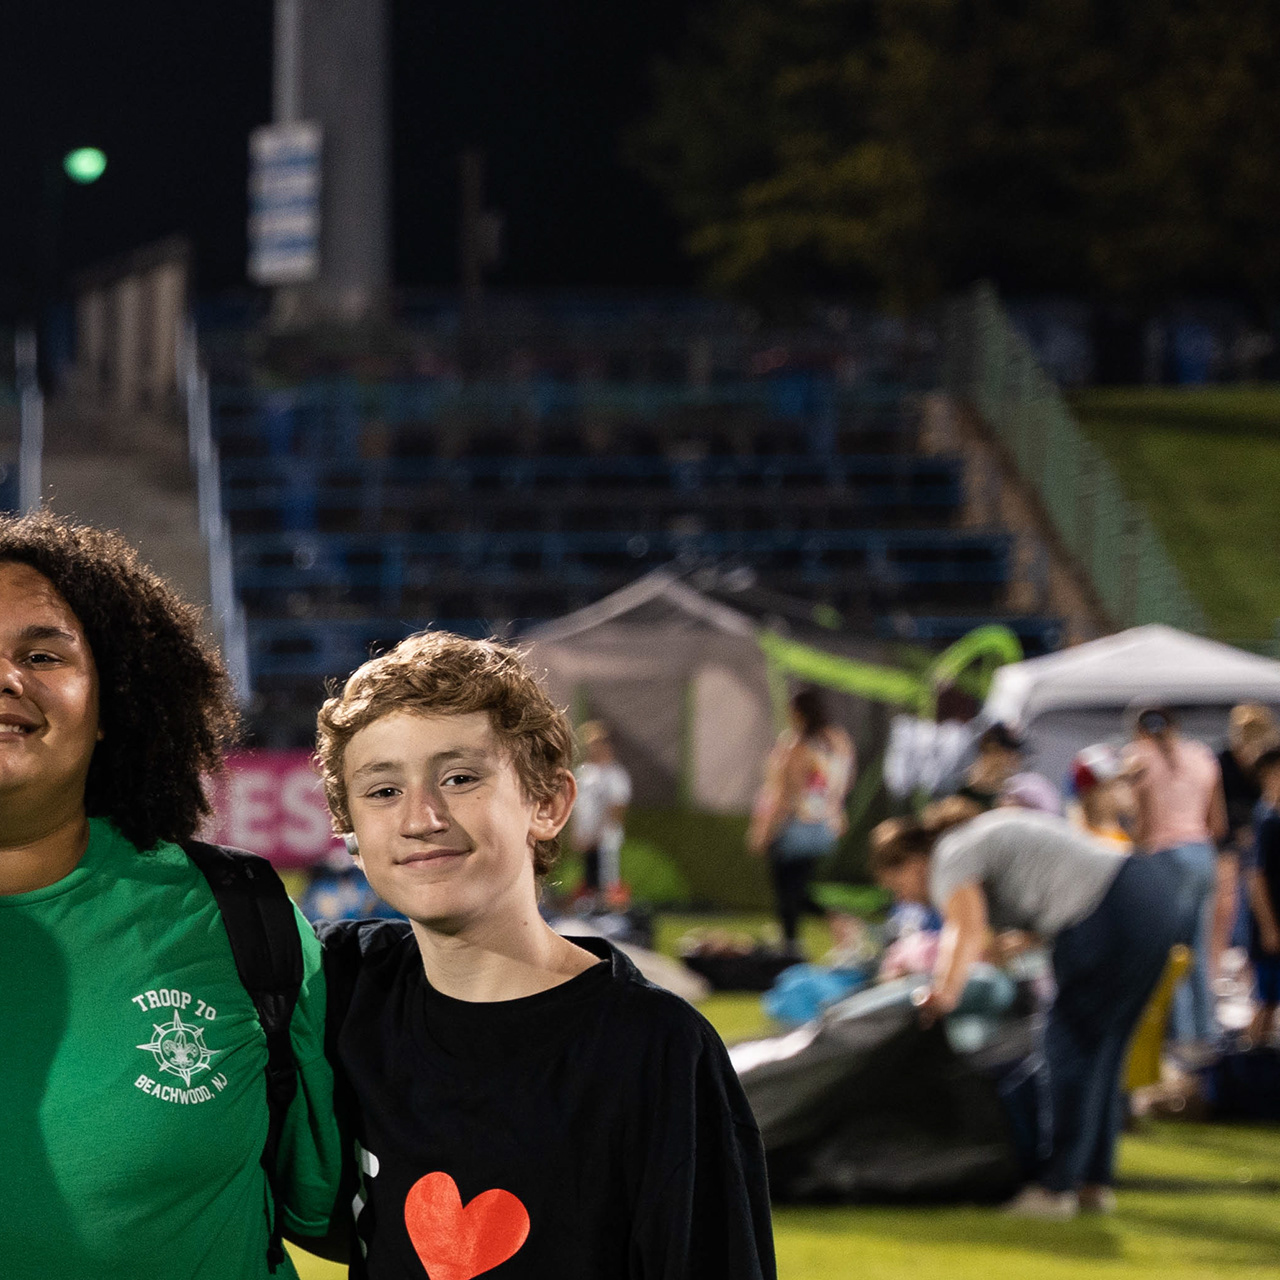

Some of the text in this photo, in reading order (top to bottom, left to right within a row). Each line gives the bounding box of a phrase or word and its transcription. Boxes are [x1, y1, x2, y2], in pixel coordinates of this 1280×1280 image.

[131, 988, 217, 1021] TROOP 70
[133, 1072, 229, 1105] BEACHWOOD, NJ
